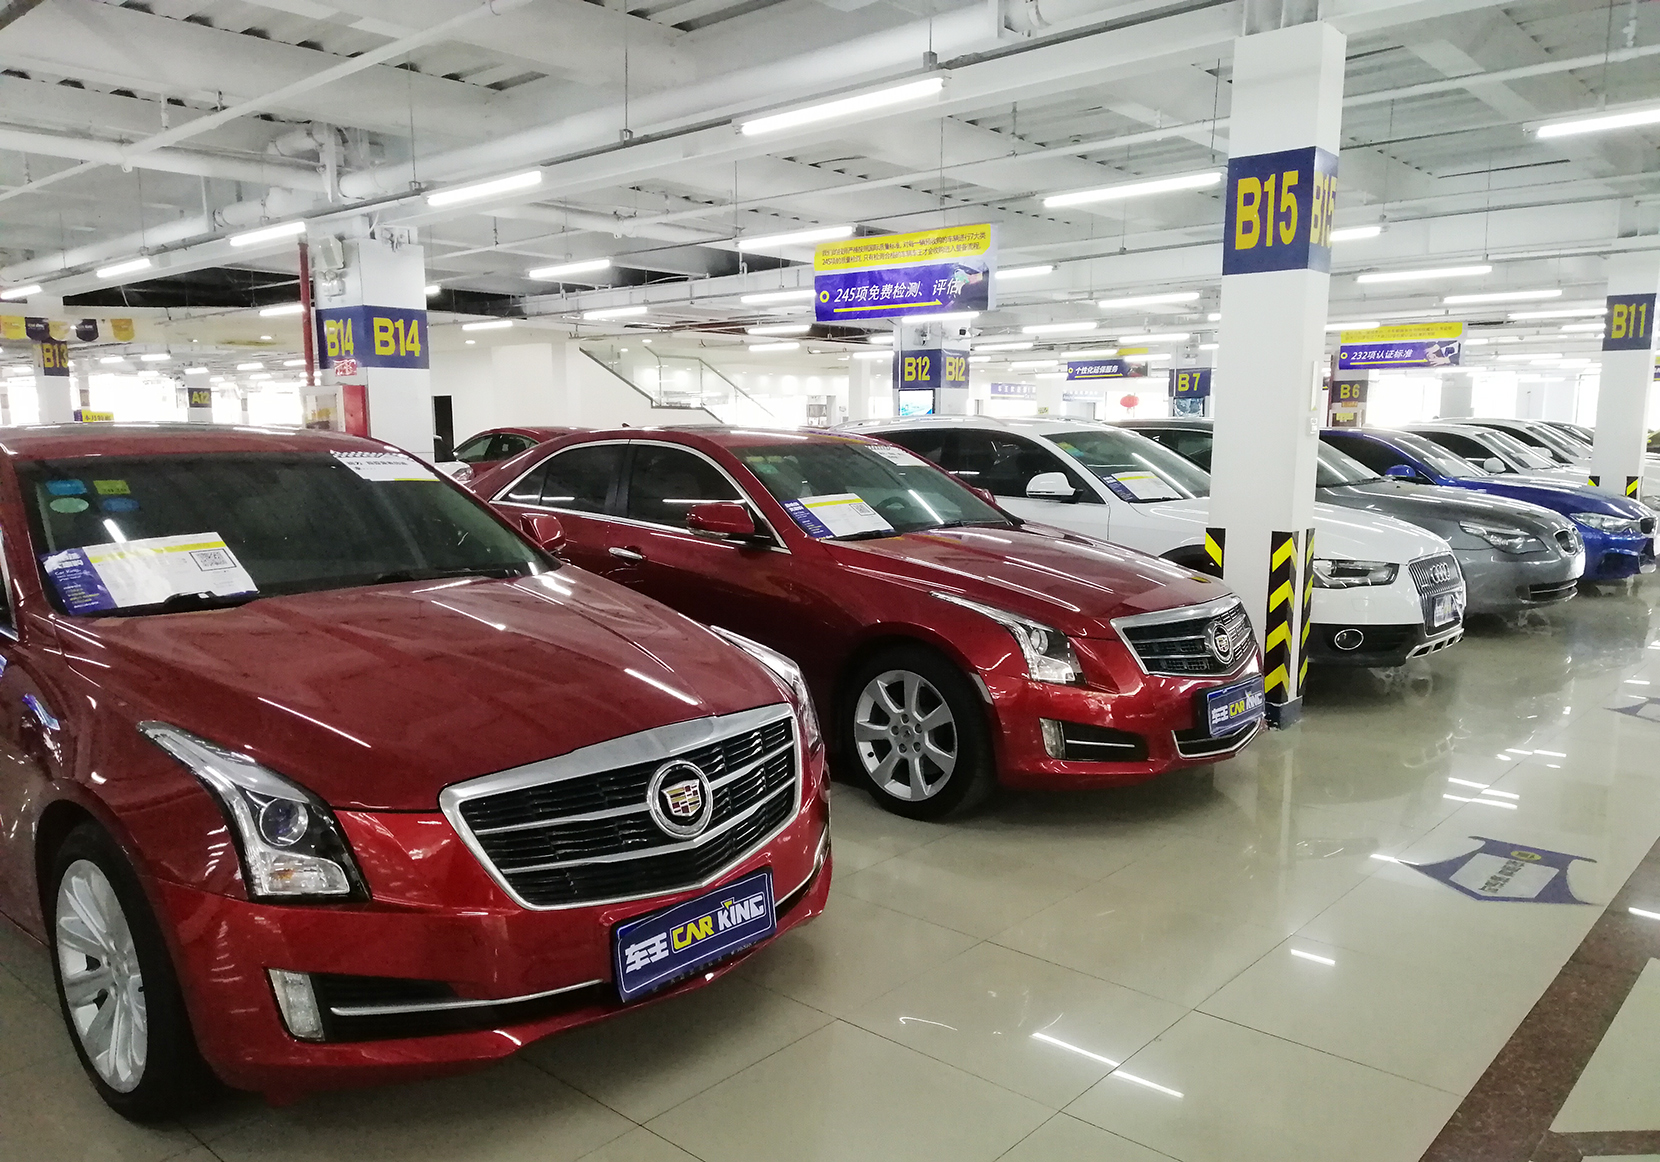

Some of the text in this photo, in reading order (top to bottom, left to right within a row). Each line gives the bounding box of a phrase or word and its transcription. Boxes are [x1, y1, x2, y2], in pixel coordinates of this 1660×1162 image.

[1235, 170, 1299, 250] B15
[1310, 171, 1337, 249] B15
[325, 318, 354, 357] B14
[373, 317, 421, 357] B14
[1611, 303, 1647, 339] B11
[43, 343, 69, 368] B13
[904, 356, 930, 381] B12
[945, 357, 966, 381] B12
[191, 391, 211, 405] A12
[1229, 700, 1245, 716] CAR
[625, 932, 669, 974] 车王
[672, 915, 715, 950] CAR
[717, 894, 765, 931] KING
